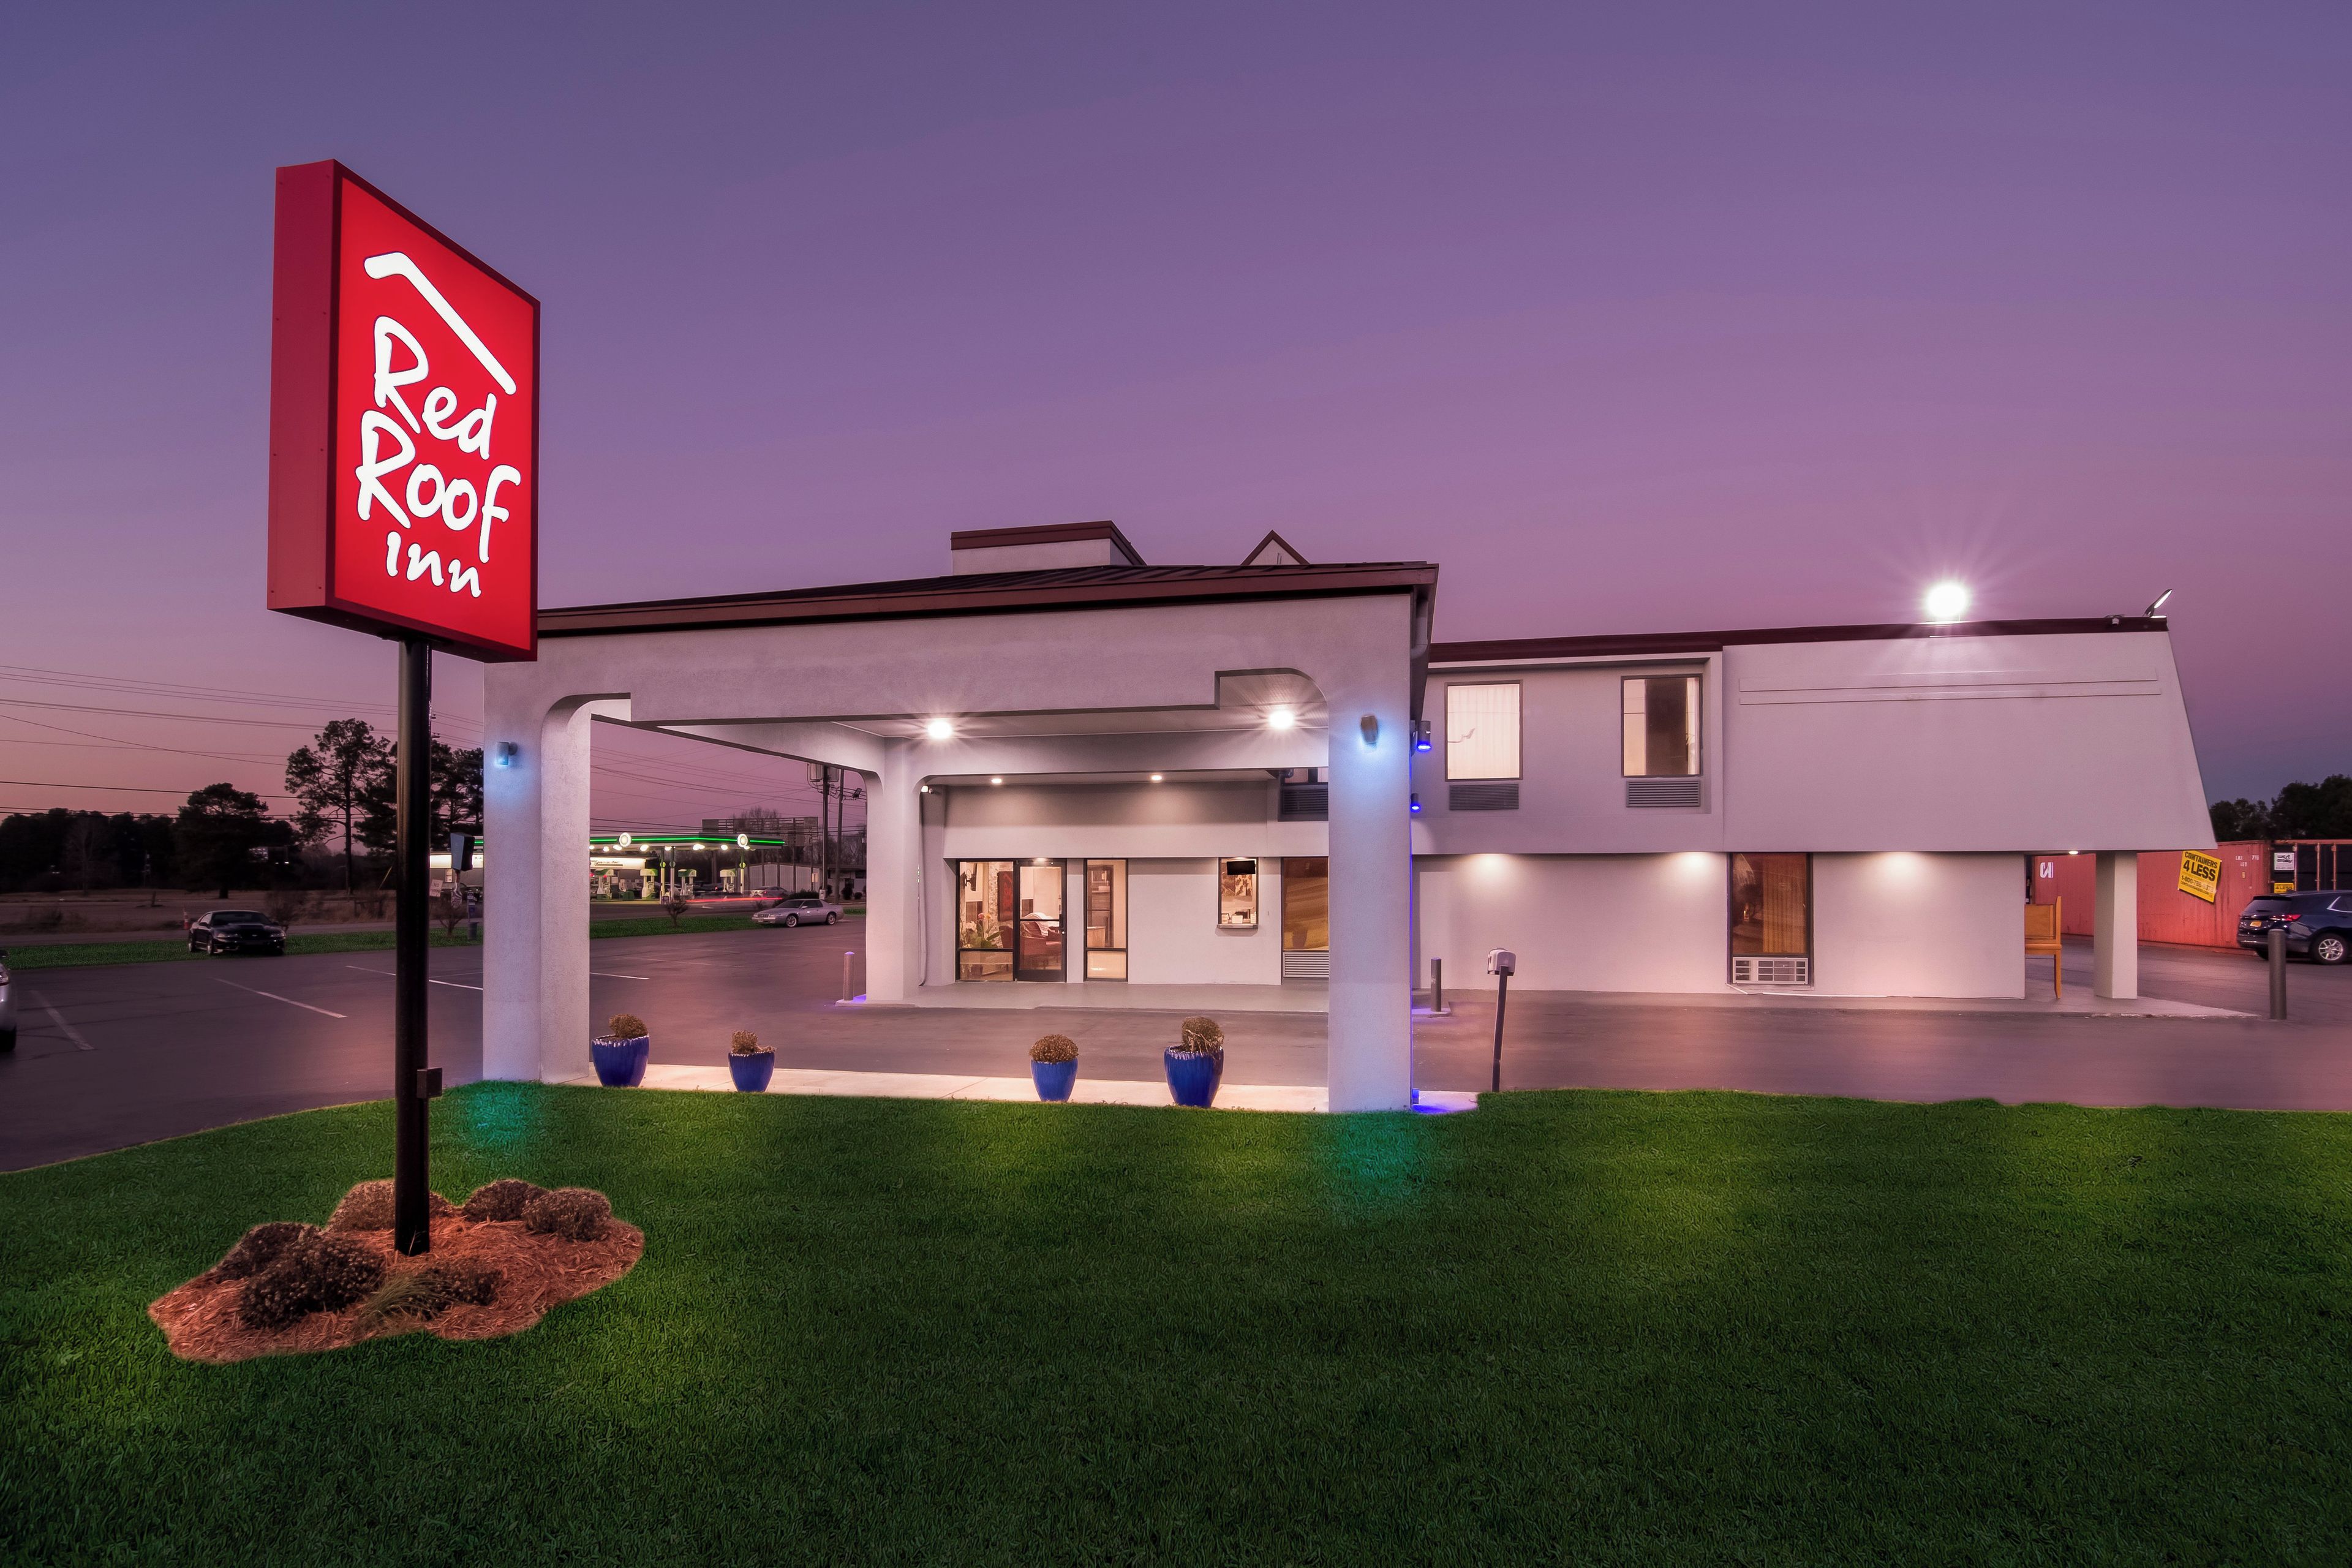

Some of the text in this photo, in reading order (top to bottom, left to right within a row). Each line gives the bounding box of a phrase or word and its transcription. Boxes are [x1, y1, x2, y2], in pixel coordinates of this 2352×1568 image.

[374, 315, 497, 460] Red
[355, 410, 521, 564] Roof
[2184, 860, 2215, 881] 4 LESS
[2185, 852, 2217, 868] CONTAINERS
